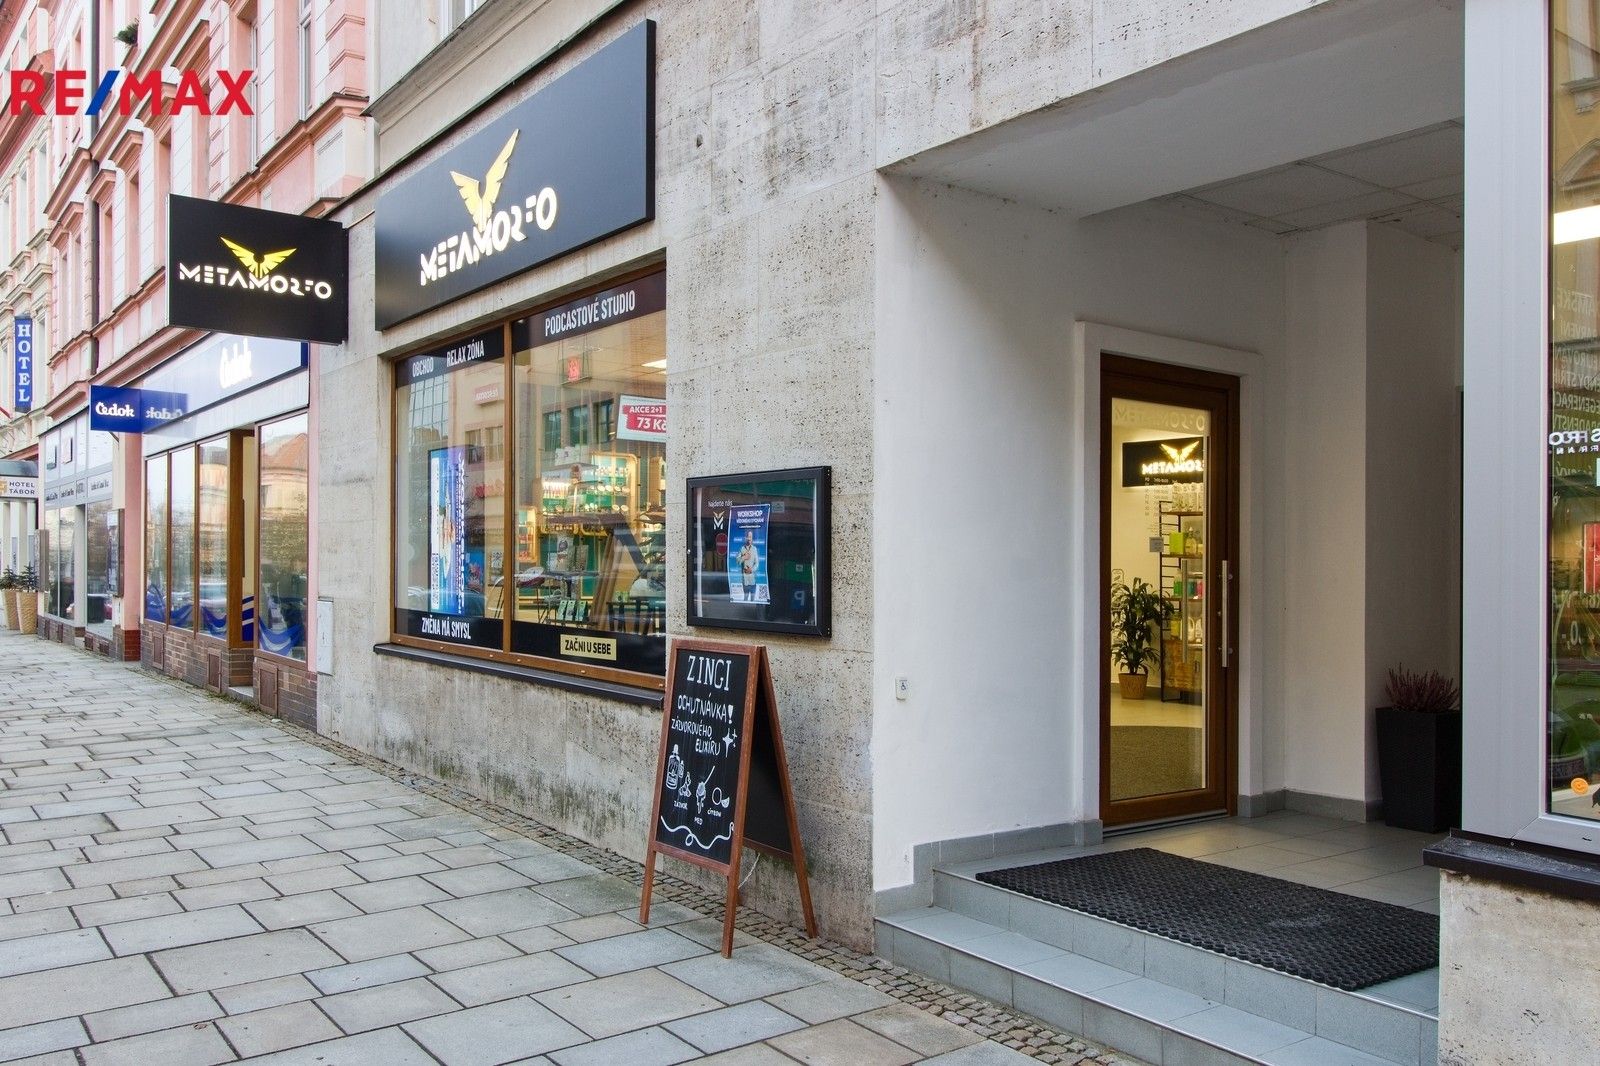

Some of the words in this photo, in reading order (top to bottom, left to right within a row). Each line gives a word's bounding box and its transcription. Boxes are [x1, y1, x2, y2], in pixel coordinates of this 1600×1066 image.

[420, 187, 558, 286] METAMORFO
[179, 263, 332, 299] METAMORFO
[545, 298, 600, 337] PODCASTOVÉ
[601, 289, 636, 320] STUDIO
[17, 324, 31, 402] HOTEL
[446, 345, 467, 368] RELAX
[467, 338, 485, 361] ZÓNA
[412, 357, 434, 378] OBCHOD
[95, 401, 135, 418] Čedok
[629, 406, 650, 414] AKCE
[650, 406, 663, 414] 2+1
[636, 416, 651, 430] 73
[421, 614, 441, 635] ZMĚNA
[441, 616, 451, 637] MÁ
[451, 620, 472, 640] SMYSL
[565, 638, 586, 653] ZAČNI
[586, 641, 592, 653] U
[592, 642, 612, 655] SEBE
[686, 655, 732, 692] ZINGI
[677, 692, 734, 725] OCHUTNÁVKA!
[695, 737, 721, 756] ELIXÍRU
